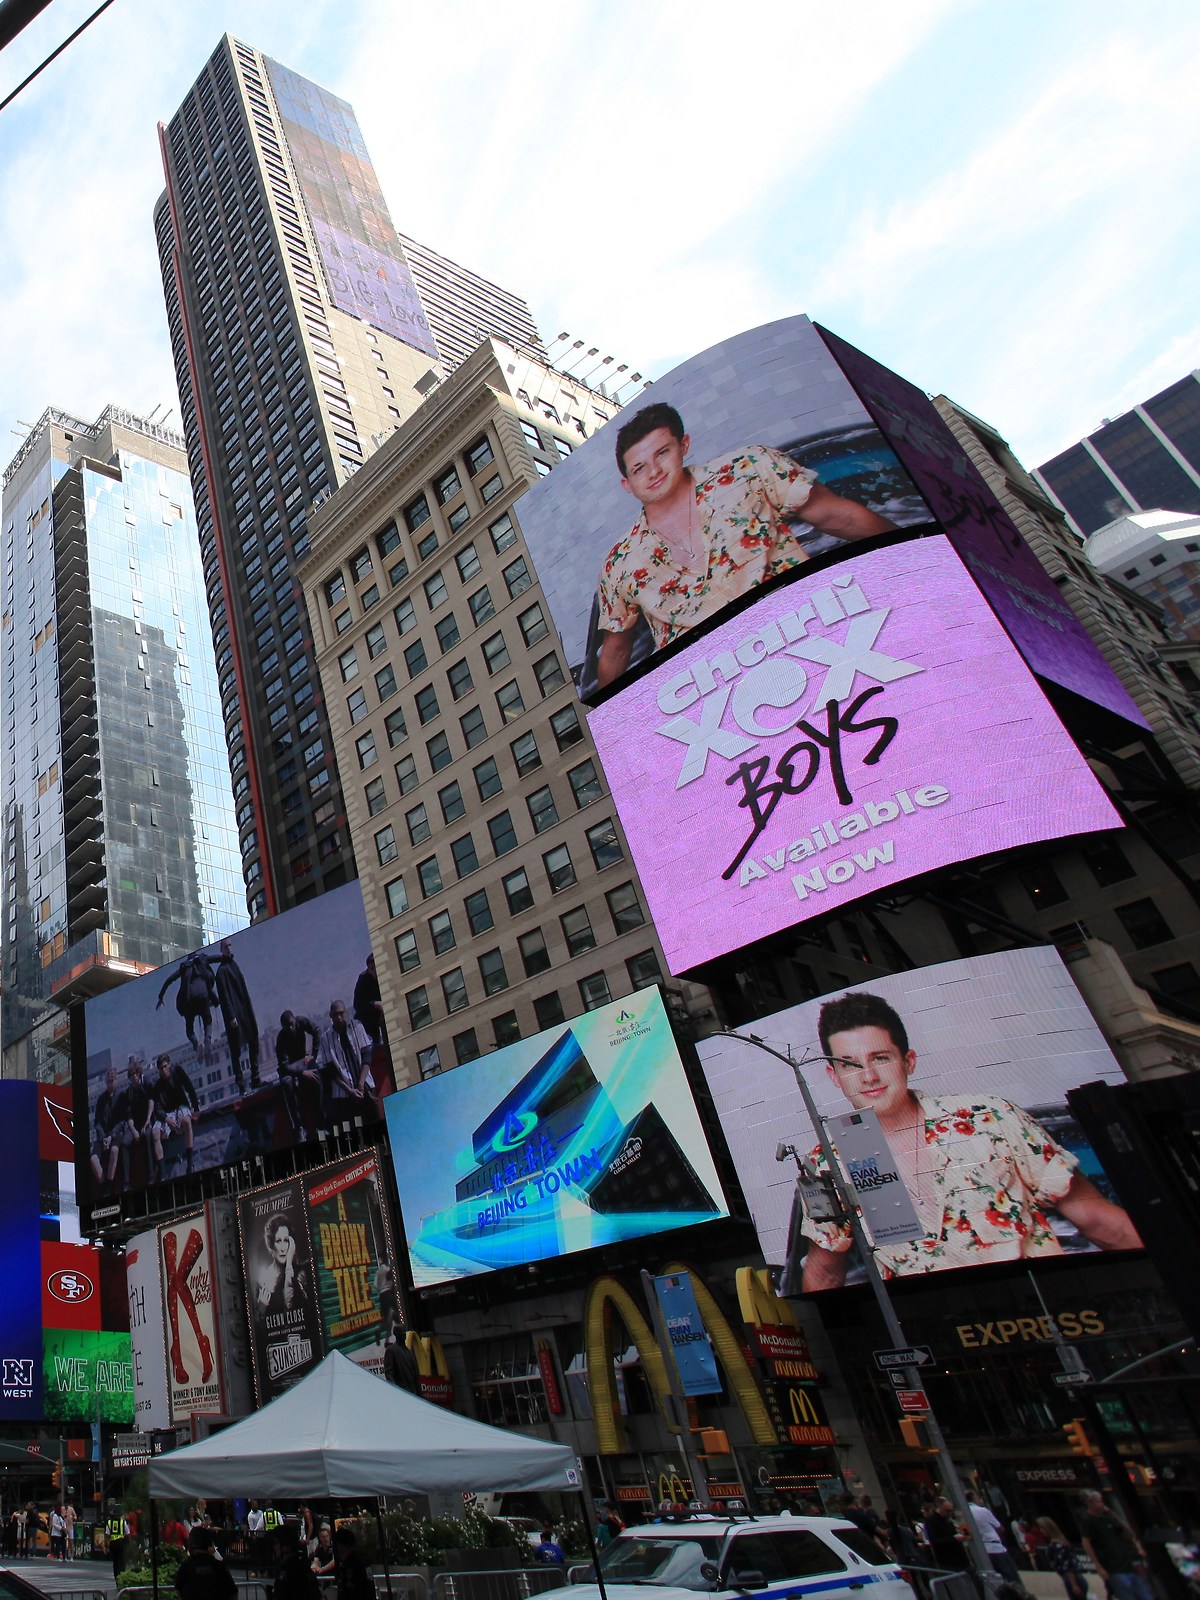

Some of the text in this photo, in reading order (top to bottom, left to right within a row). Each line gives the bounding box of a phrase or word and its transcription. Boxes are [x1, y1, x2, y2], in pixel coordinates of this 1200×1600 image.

[656, 574, 872, 716] charli
[721, 685, 899, 881] BOYS
[738, 783, 951, 889] Available
[789, 838, 897, 902] Now
[633, 1026, 652, 1037] TOWN
[345, 1166, 363, 1184] CRITICS'
[363, 1161, 375, 1173] PICK
[612, 1152, 642, 1176] CLOUD VALLEY
[846, 1157, 878, 1171] DEAR
[850, 1166, 880, 1181] EVAN
[477, 1147, 604, 1230] BEIJING TOWN
[853, 1171, 899, 1191] HANSEN
[254, 1195, 291, 1217] TRIUMPH!
[336, 1192, 347, 1221] A
[319, 1222, 372, 1270] BRONX
[59, 1274, 85, 1300] SF
[332, 1265, 376, 1318] TALE
[265, 1308, 305, 1329] GLENN CLOSE
[666, 1317, 691, 1328] DEAR
[955, 1309, 1105, 1348] EXPRESS
[668, 1325, 691, 1336] EVAN
[670, 1331, 706, 1345] HANSEN
[272, 1343, 300, 1374] SUNSET
[881, 1352, 915, 1364] ONE WAY
[53, 1356, 134, 1393] WE ARE
[3, 1389, 34, 1398] WEST
[173, 1386, 205, 1400] WINNER! TONY
[145, 1400, 152, 1410] 25
[26, 1445, 41, 1453] CNY
[1015, 1468, 1077, 1482] EXPRESS
